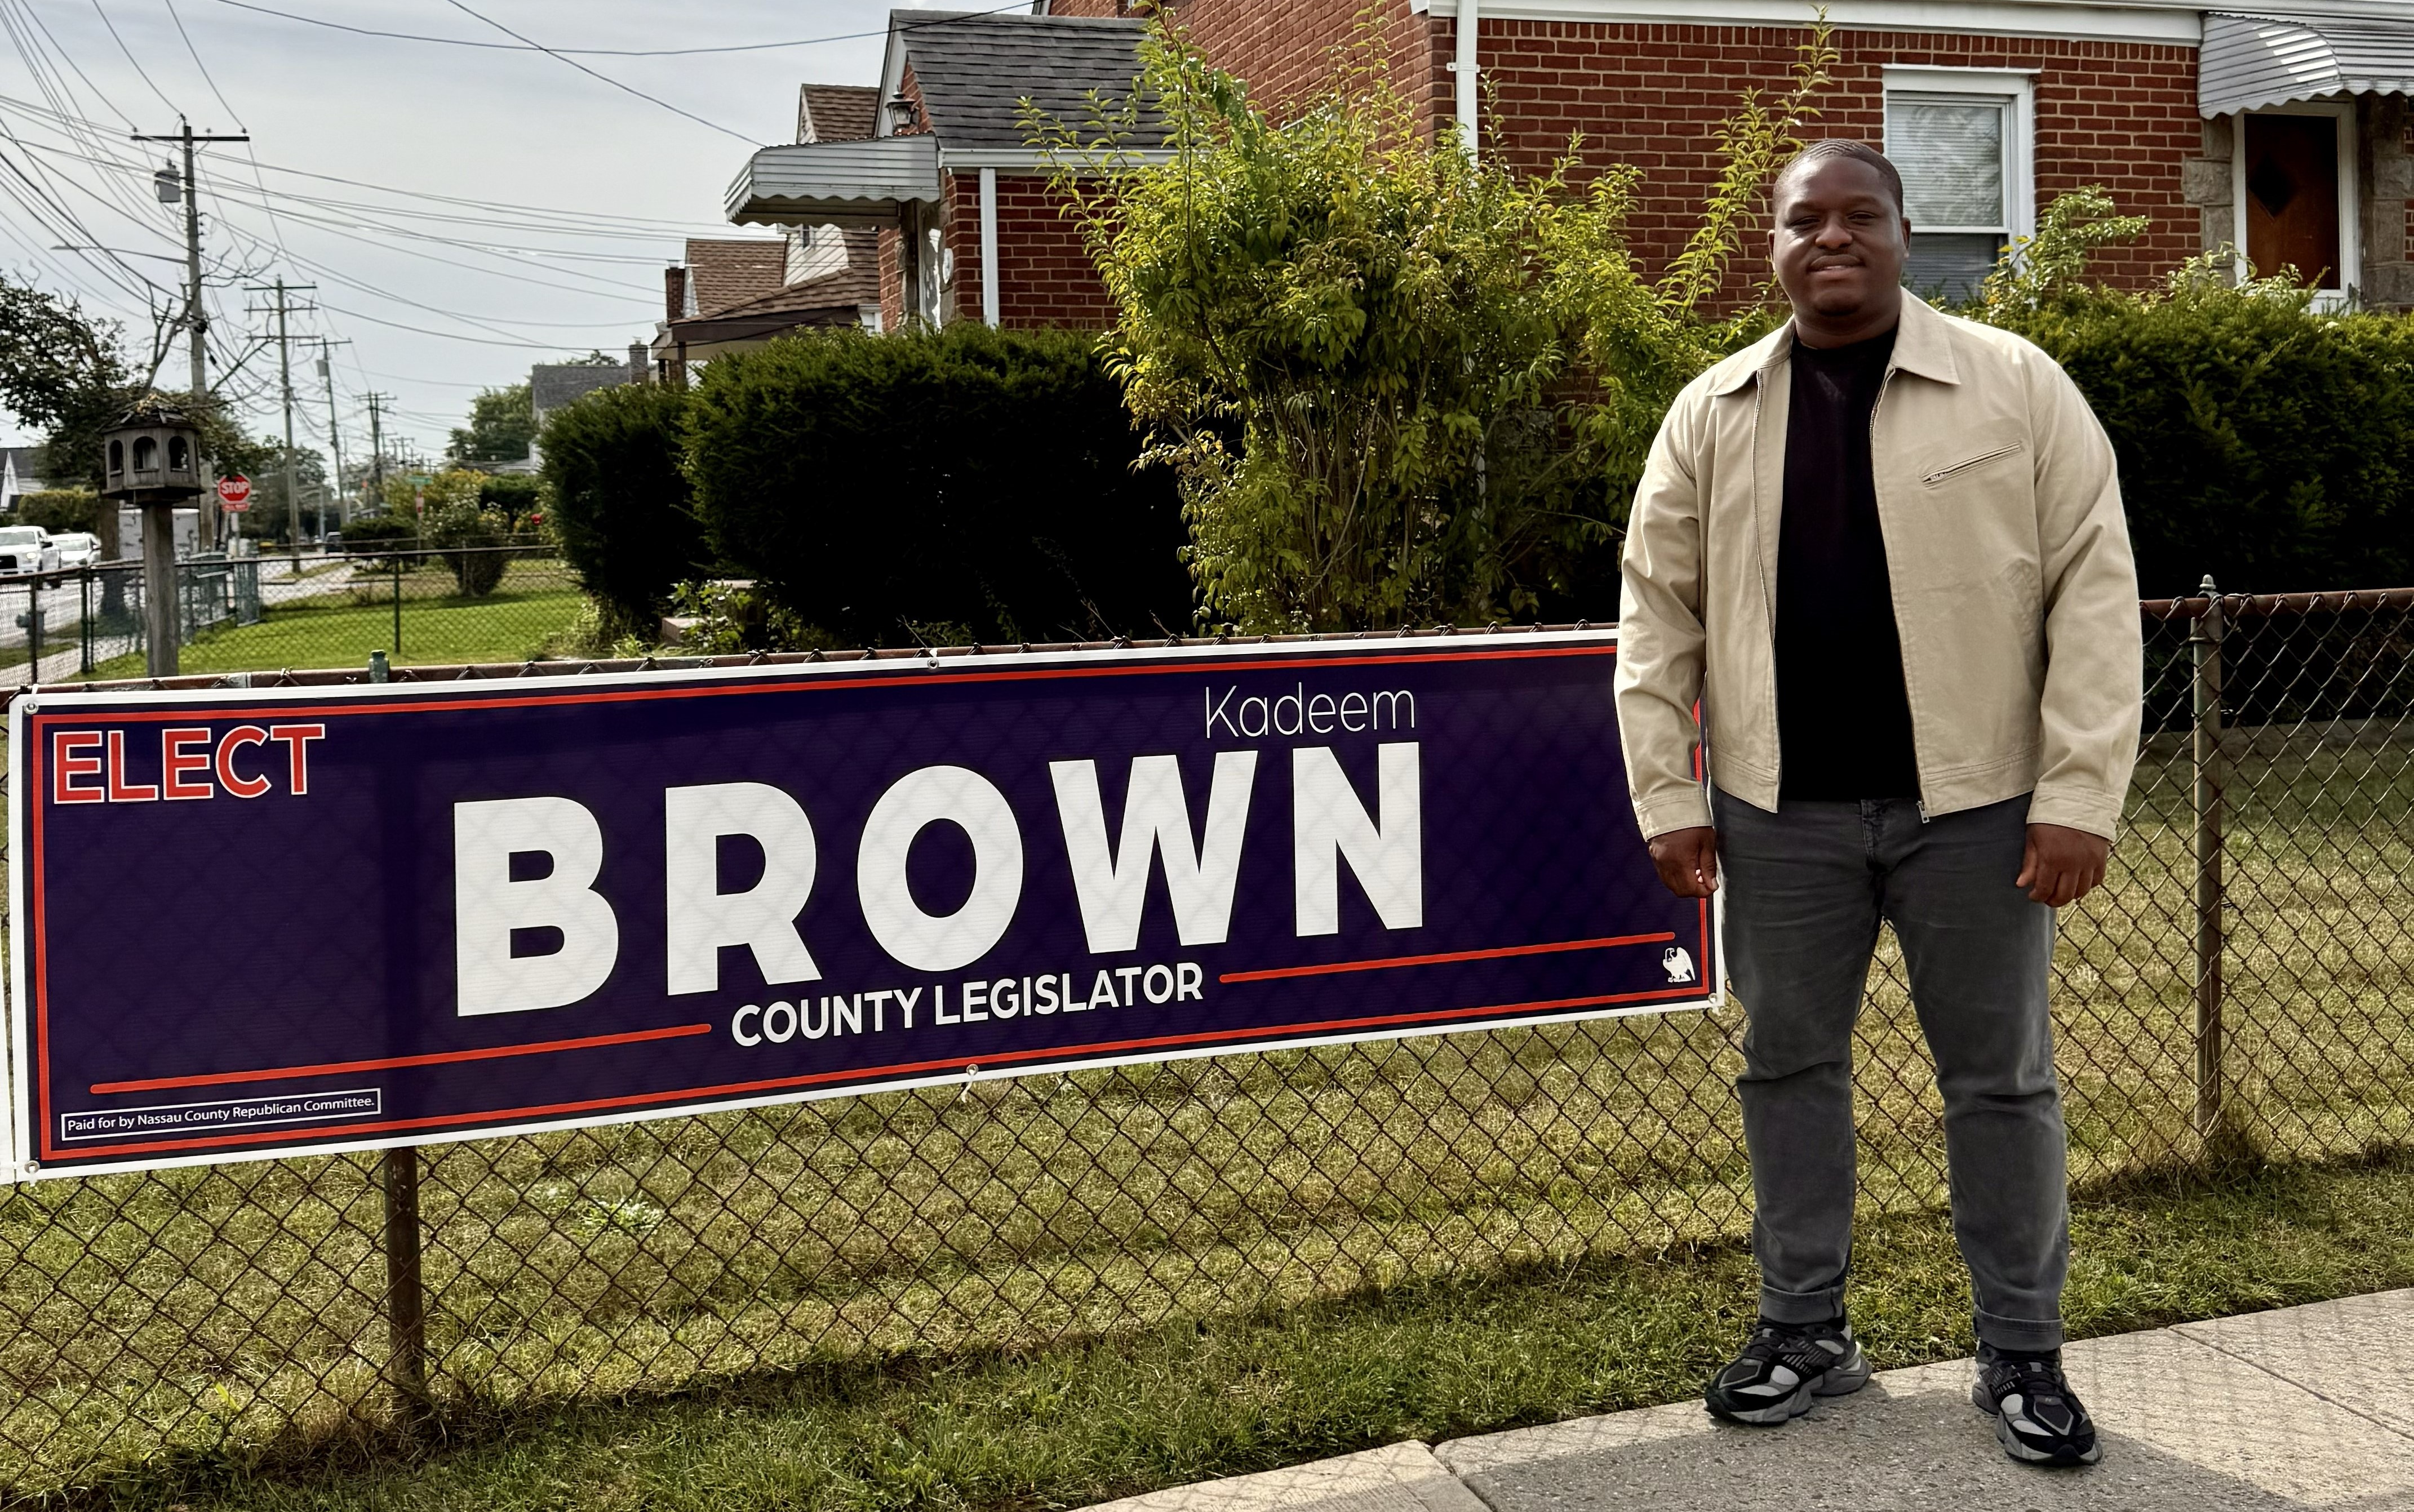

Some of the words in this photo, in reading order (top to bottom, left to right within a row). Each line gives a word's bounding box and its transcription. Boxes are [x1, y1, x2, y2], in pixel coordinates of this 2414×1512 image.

[221, 481, 250, 494] STOP
[1205, 682, 1415, 739] Kadeem
[54, 723, 325, 804] ELECT
[454, 741, 1423, 1017] BROWN
[731, 987, 923, 1047] COUNTY
[935, 962, 1204, 1025] LEGISLATOR
[68, 1118, 95, 1131] Paid
[98, 1117, 116, 1129] for
[119, 1116, 135, 1129] by
[137, 1114, 182, 1126] Nassau
[184, 1109, 230, 1122] County
[233, 1103, 301, 1119] Republican
[304, 1097, 375, 1112] Committee.
